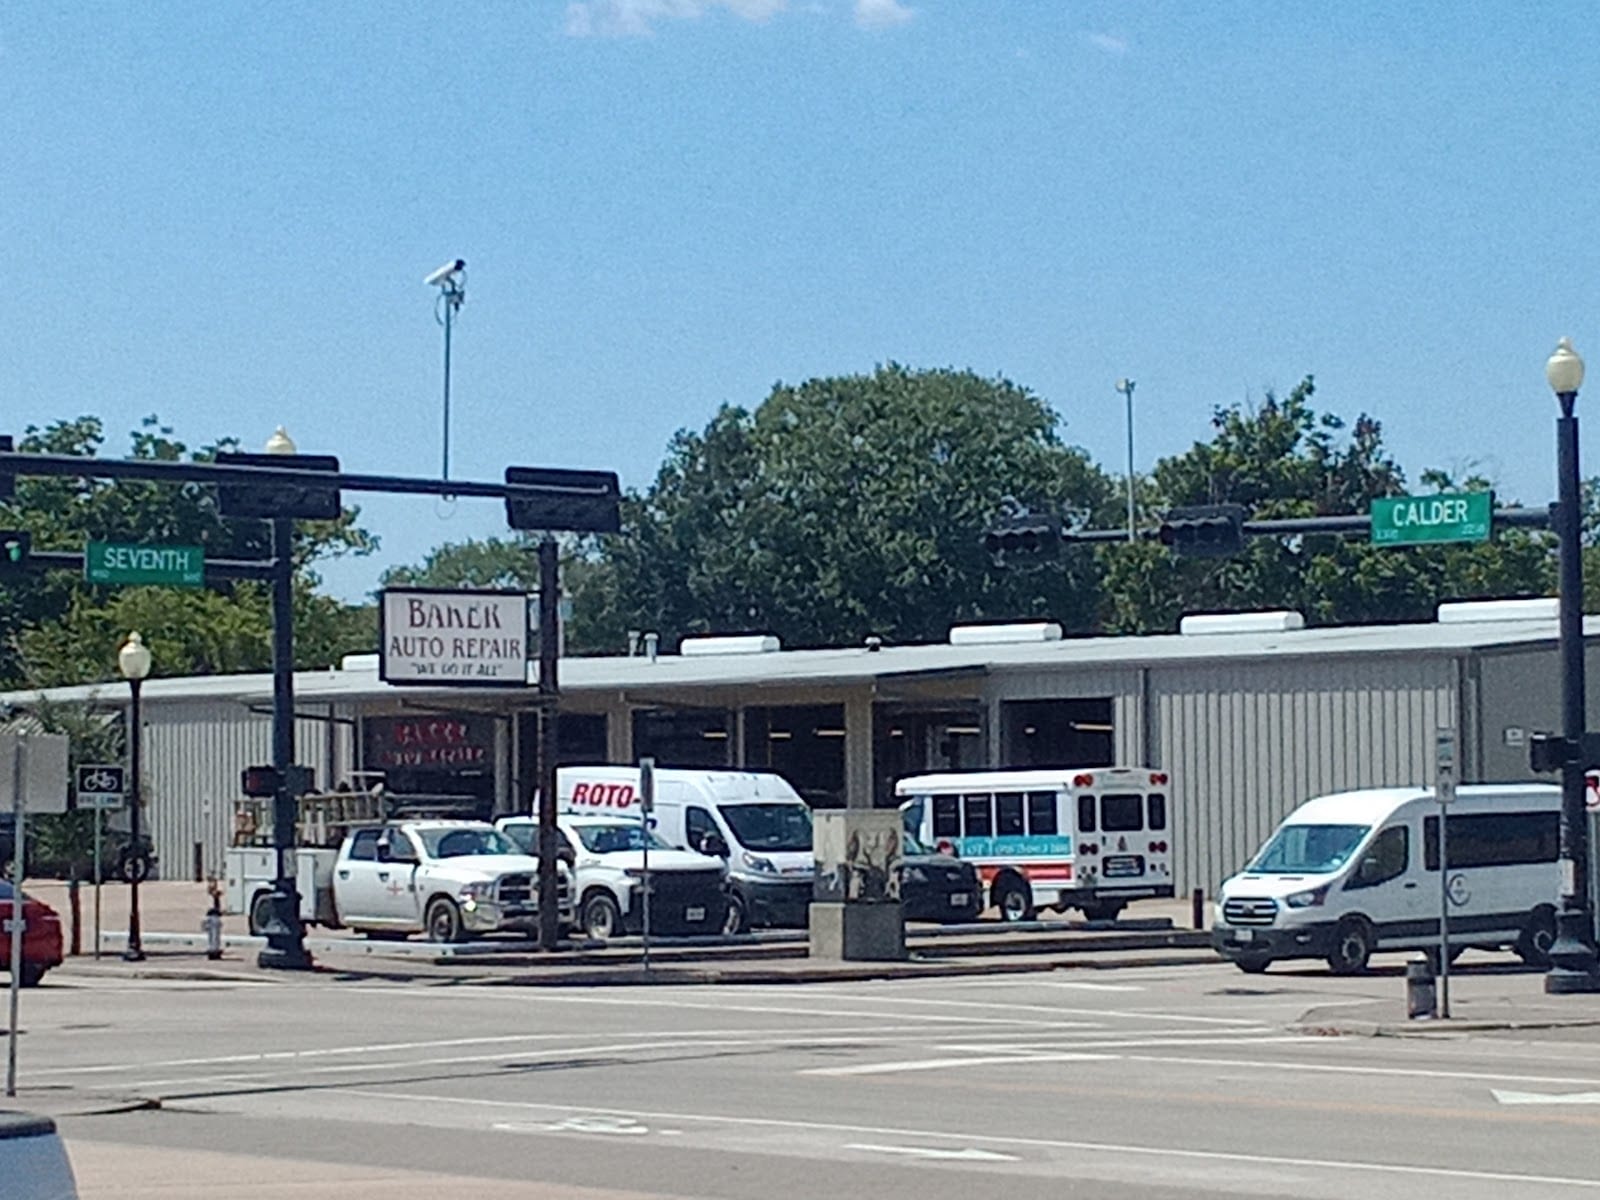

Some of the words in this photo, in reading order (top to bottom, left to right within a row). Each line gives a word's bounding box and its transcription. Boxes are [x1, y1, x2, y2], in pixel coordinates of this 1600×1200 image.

[1392, 499, 1469, 527] CALDER
[103, 547, 190, 571] SEVENTH
[407, 598, 502, 629] BAKER
[389, 636, 445, 658] AUTO
[452, 637, 522, 660] REPAIR
